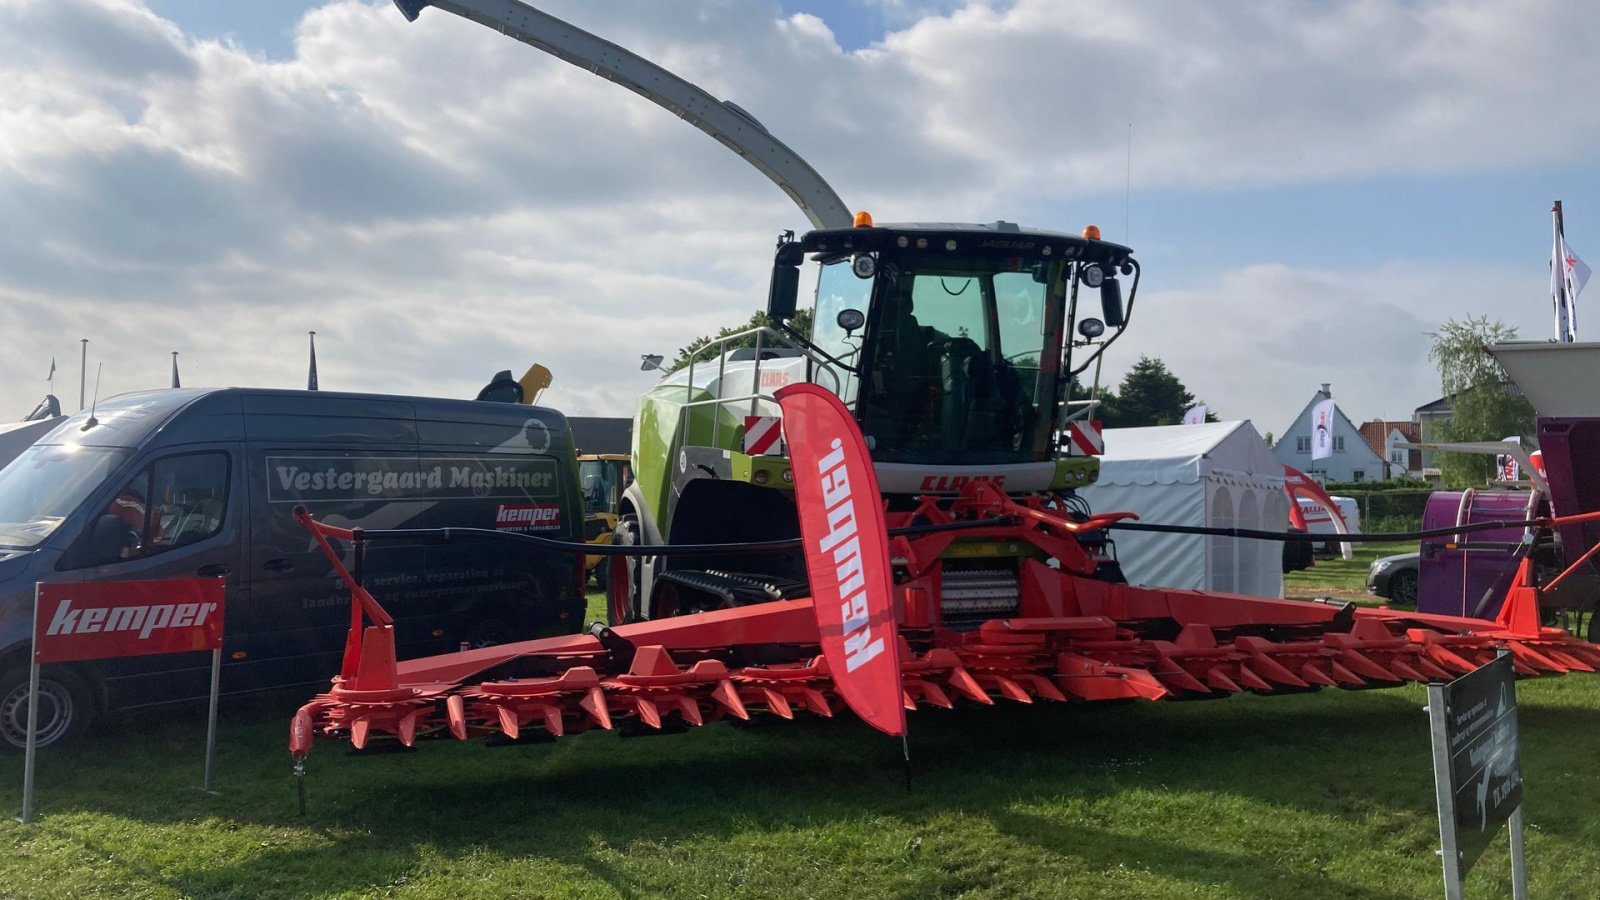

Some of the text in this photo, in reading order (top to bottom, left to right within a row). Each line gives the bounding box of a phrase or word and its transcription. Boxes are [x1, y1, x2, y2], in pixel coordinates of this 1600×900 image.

[978, 240, 1036, 249] JAGUAR
[276, 466, 553, 495] Vestergaard Maskiner
[497, 505, 560, 526] kemper
[818, 437, 884, 672] kemper
[46, 600, 217, 640] kemper
